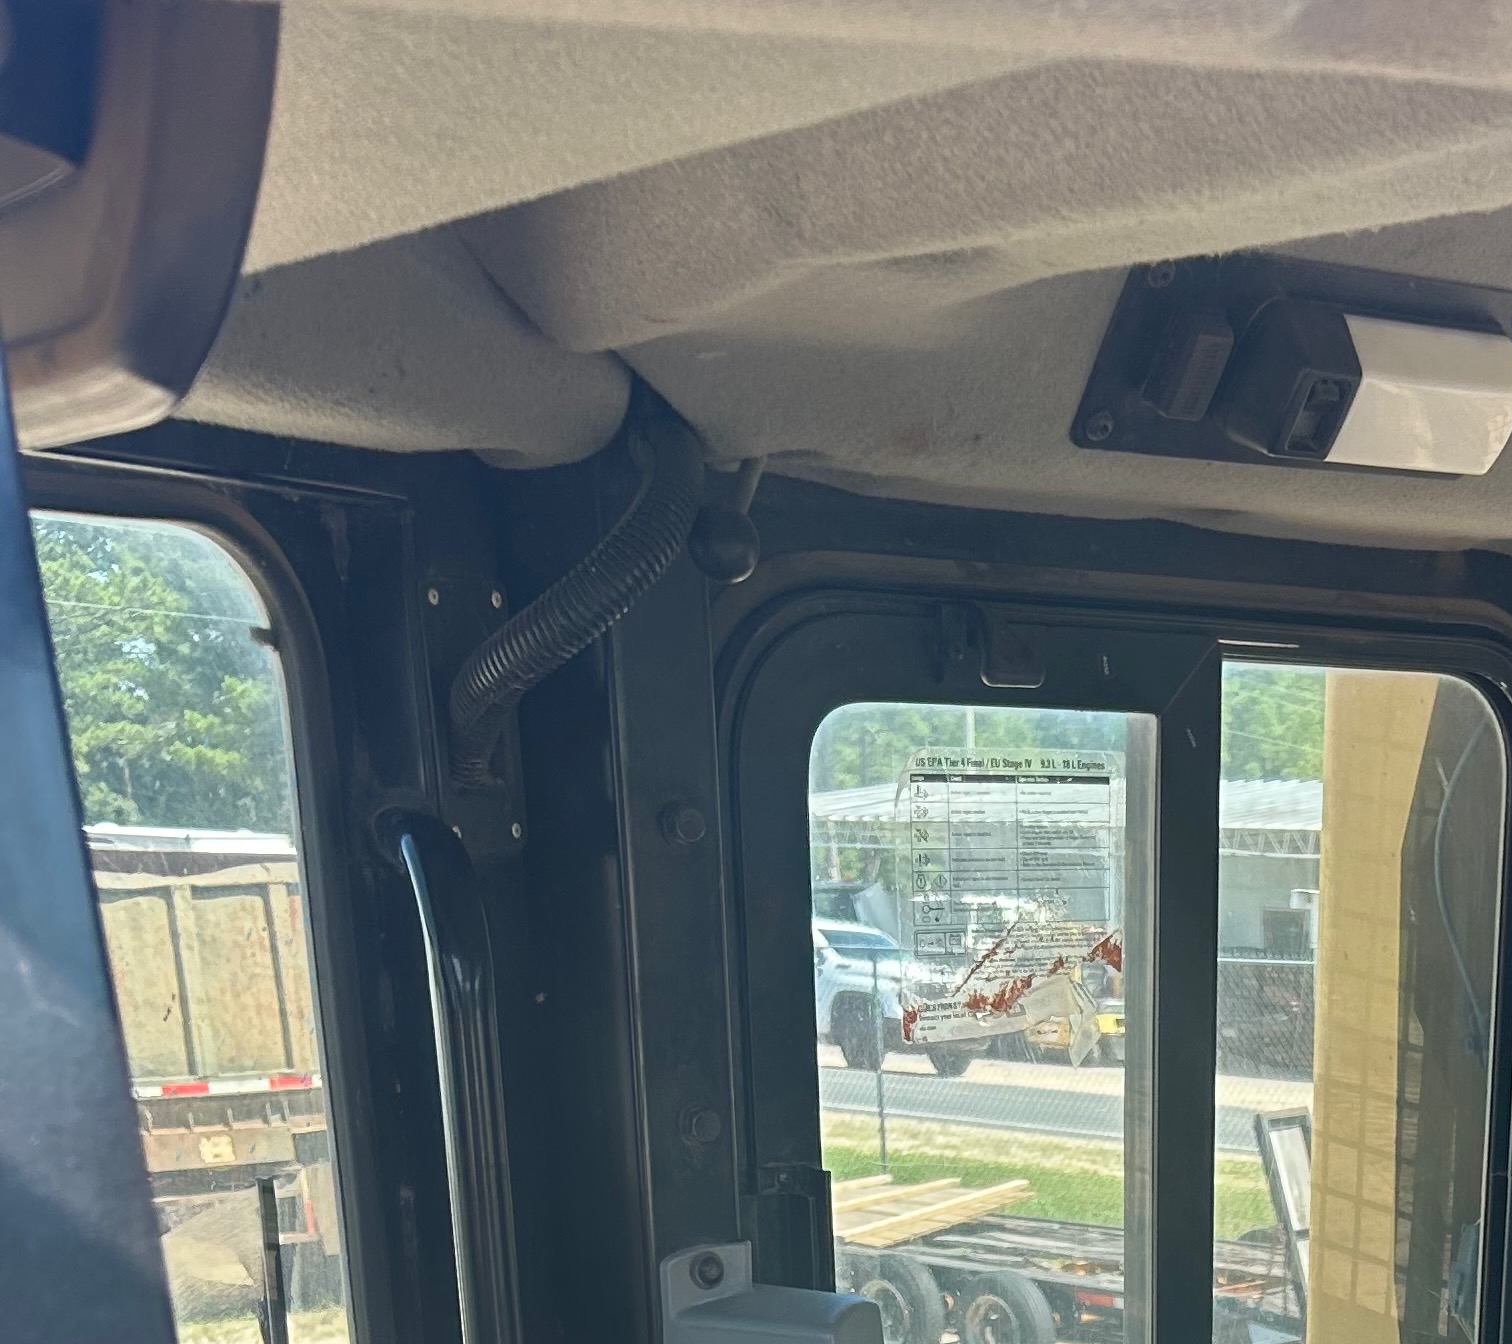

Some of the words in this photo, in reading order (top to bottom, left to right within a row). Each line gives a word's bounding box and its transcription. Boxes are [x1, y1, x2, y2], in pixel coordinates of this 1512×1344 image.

[915, 757, 926, 767] US
[927, 757, 942, 768] EPA
[944, 757, 960, 768] Tier
[991, 758, 1001, 768] EU
[1002, 758, 1023, 770] Stage
[1077, 760, 1105, 771] Engines
